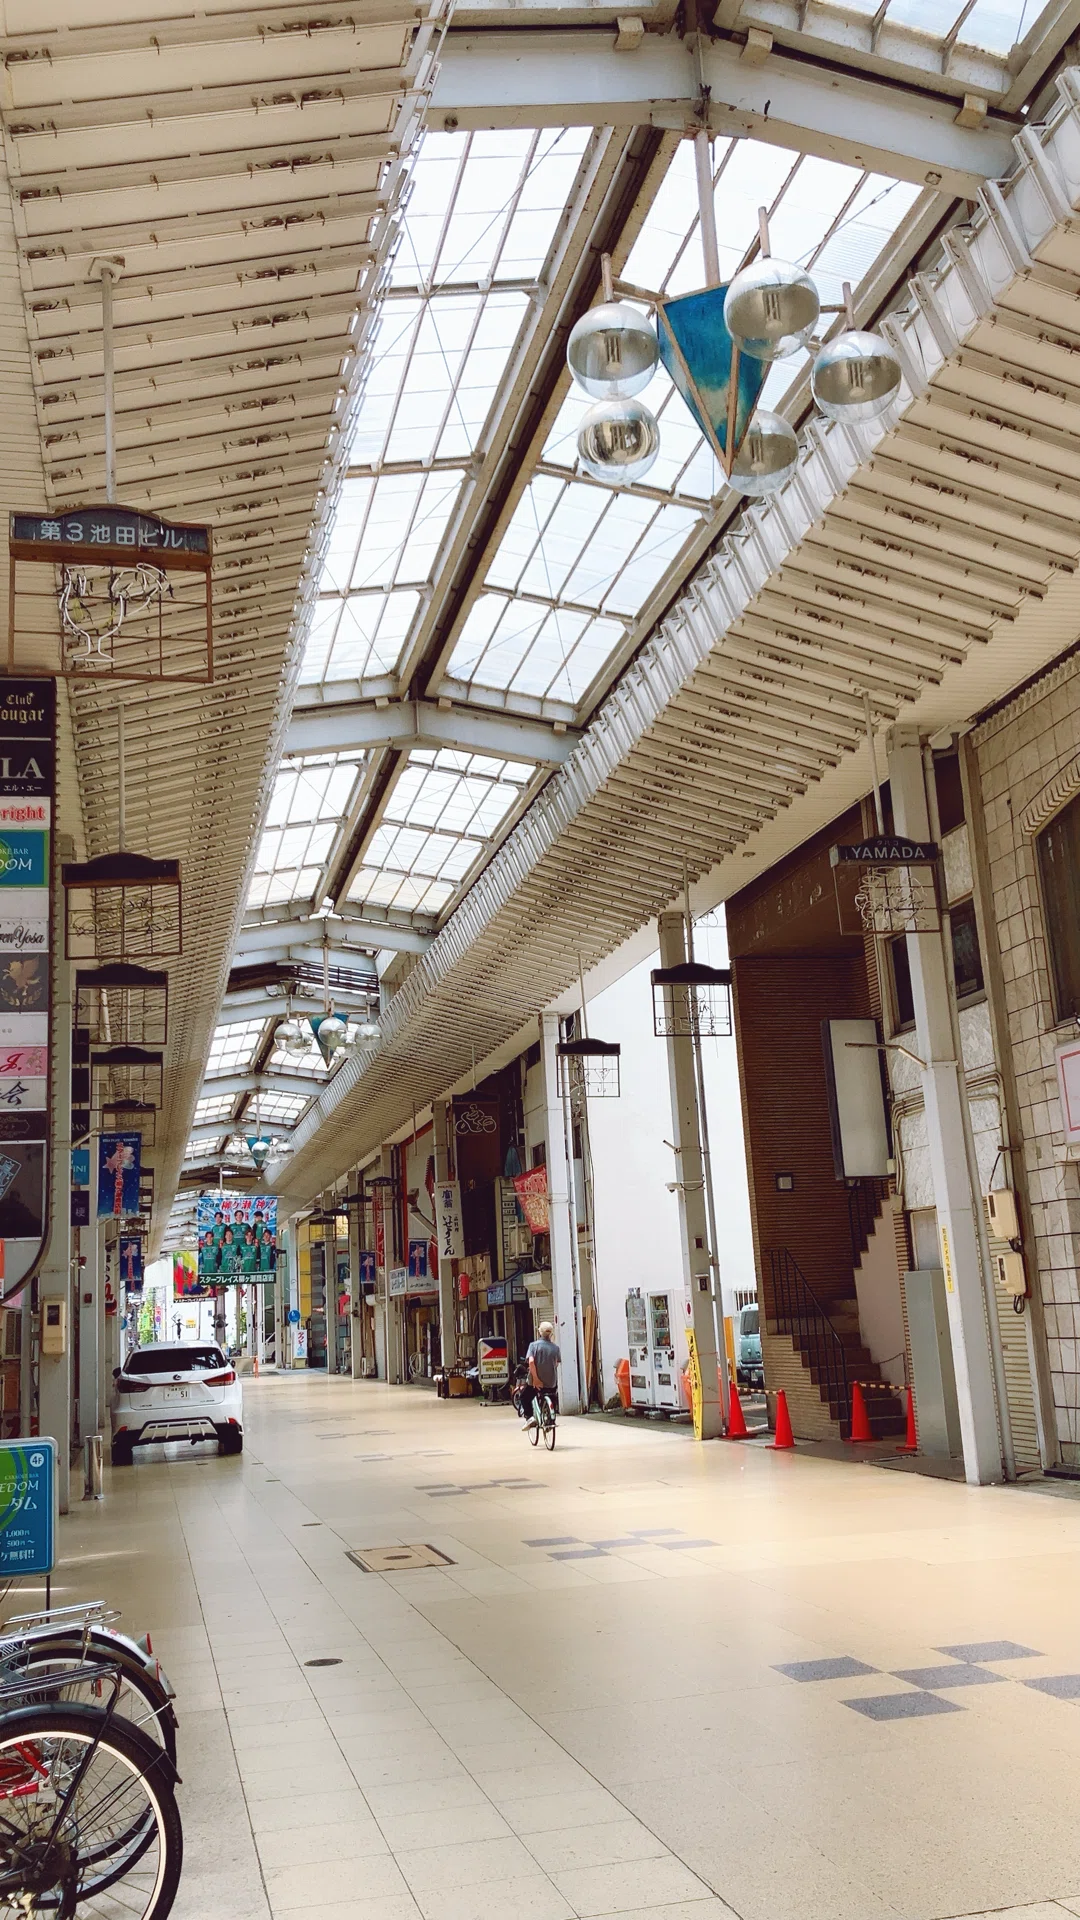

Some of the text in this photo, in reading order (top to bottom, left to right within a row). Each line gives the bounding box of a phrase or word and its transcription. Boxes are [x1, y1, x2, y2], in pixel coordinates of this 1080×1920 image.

[40, 520, 183, 548] 第3池田ビル
[6, 693, 32, 705] Club
[0, 707, 44, 724] ougar
[851, 846, 925, 859] YAMADA
[32, 1456, 42, 1465] 4F
